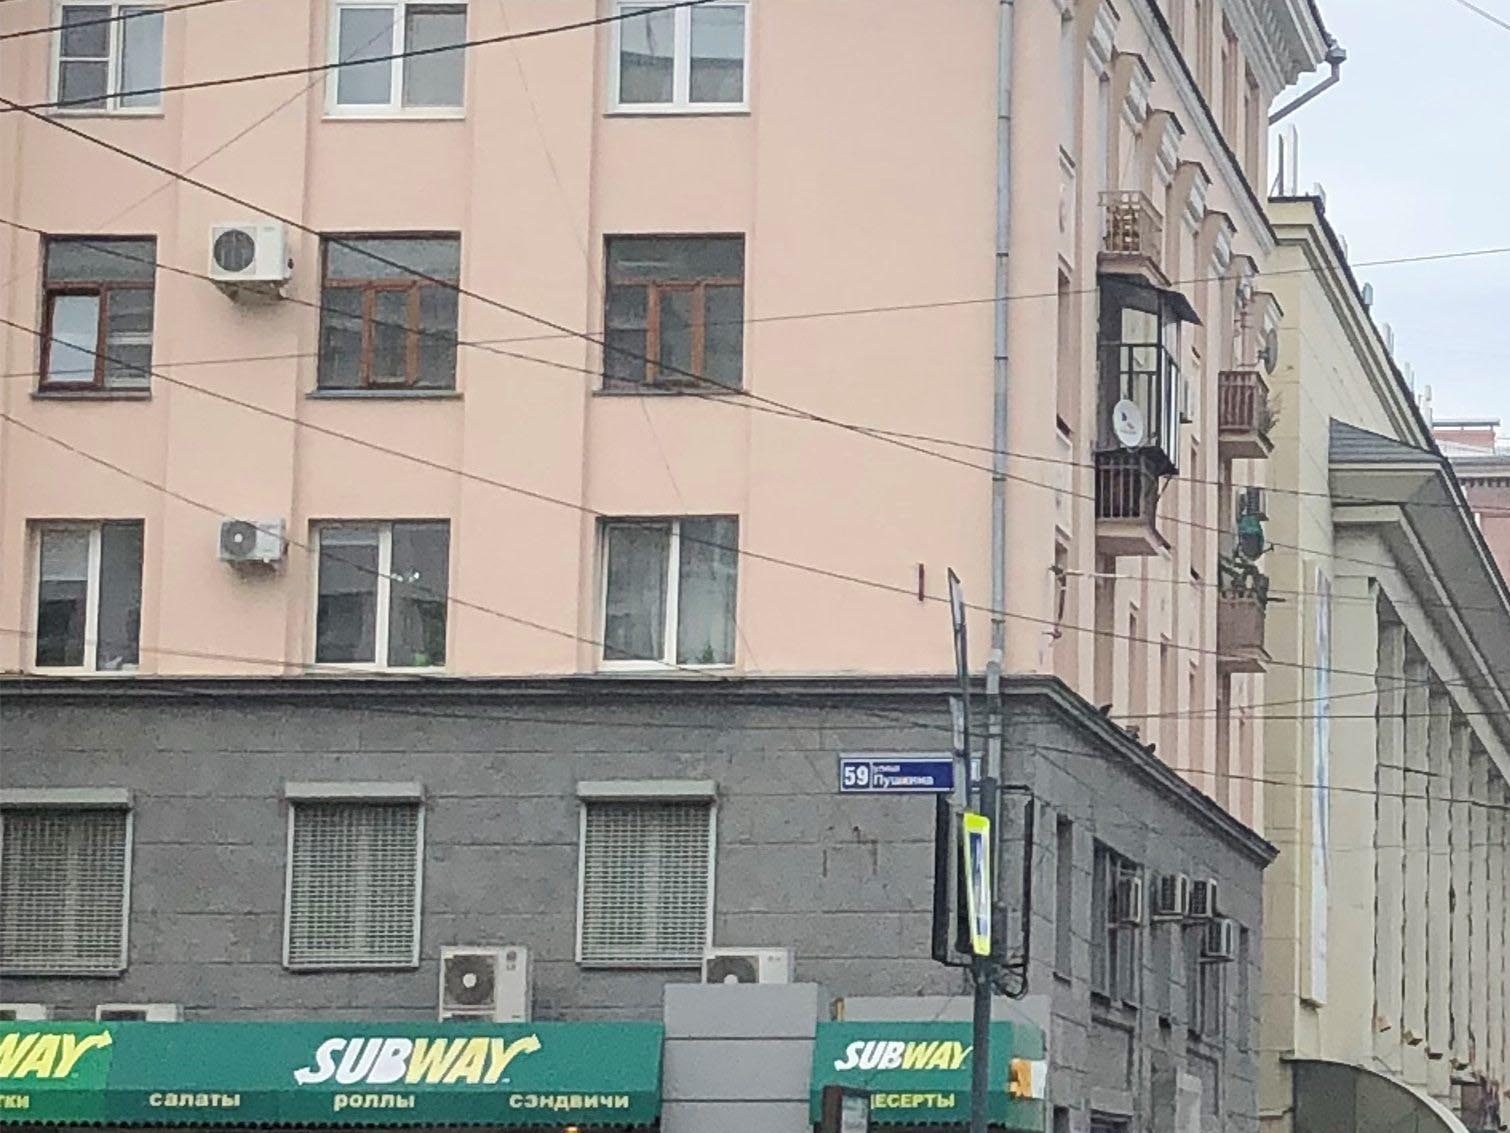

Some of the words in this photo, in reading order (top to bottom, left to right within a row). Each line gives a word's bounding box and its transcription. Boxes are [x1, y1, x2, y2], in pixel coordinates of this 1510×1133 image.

[844, 765, 869, 786] 59
[294, 1034, 541, 1085] SUBWAY
[834, 1040, 974, 1071] SUBWAY
[149, 1092, 241, 1108] салаты
[333, 1094, 416, 1111] роллы
[509, 1094, 629, 1111] сэндвичи
[871, 1092, 956, 1110] ЕСЕРТЫ
